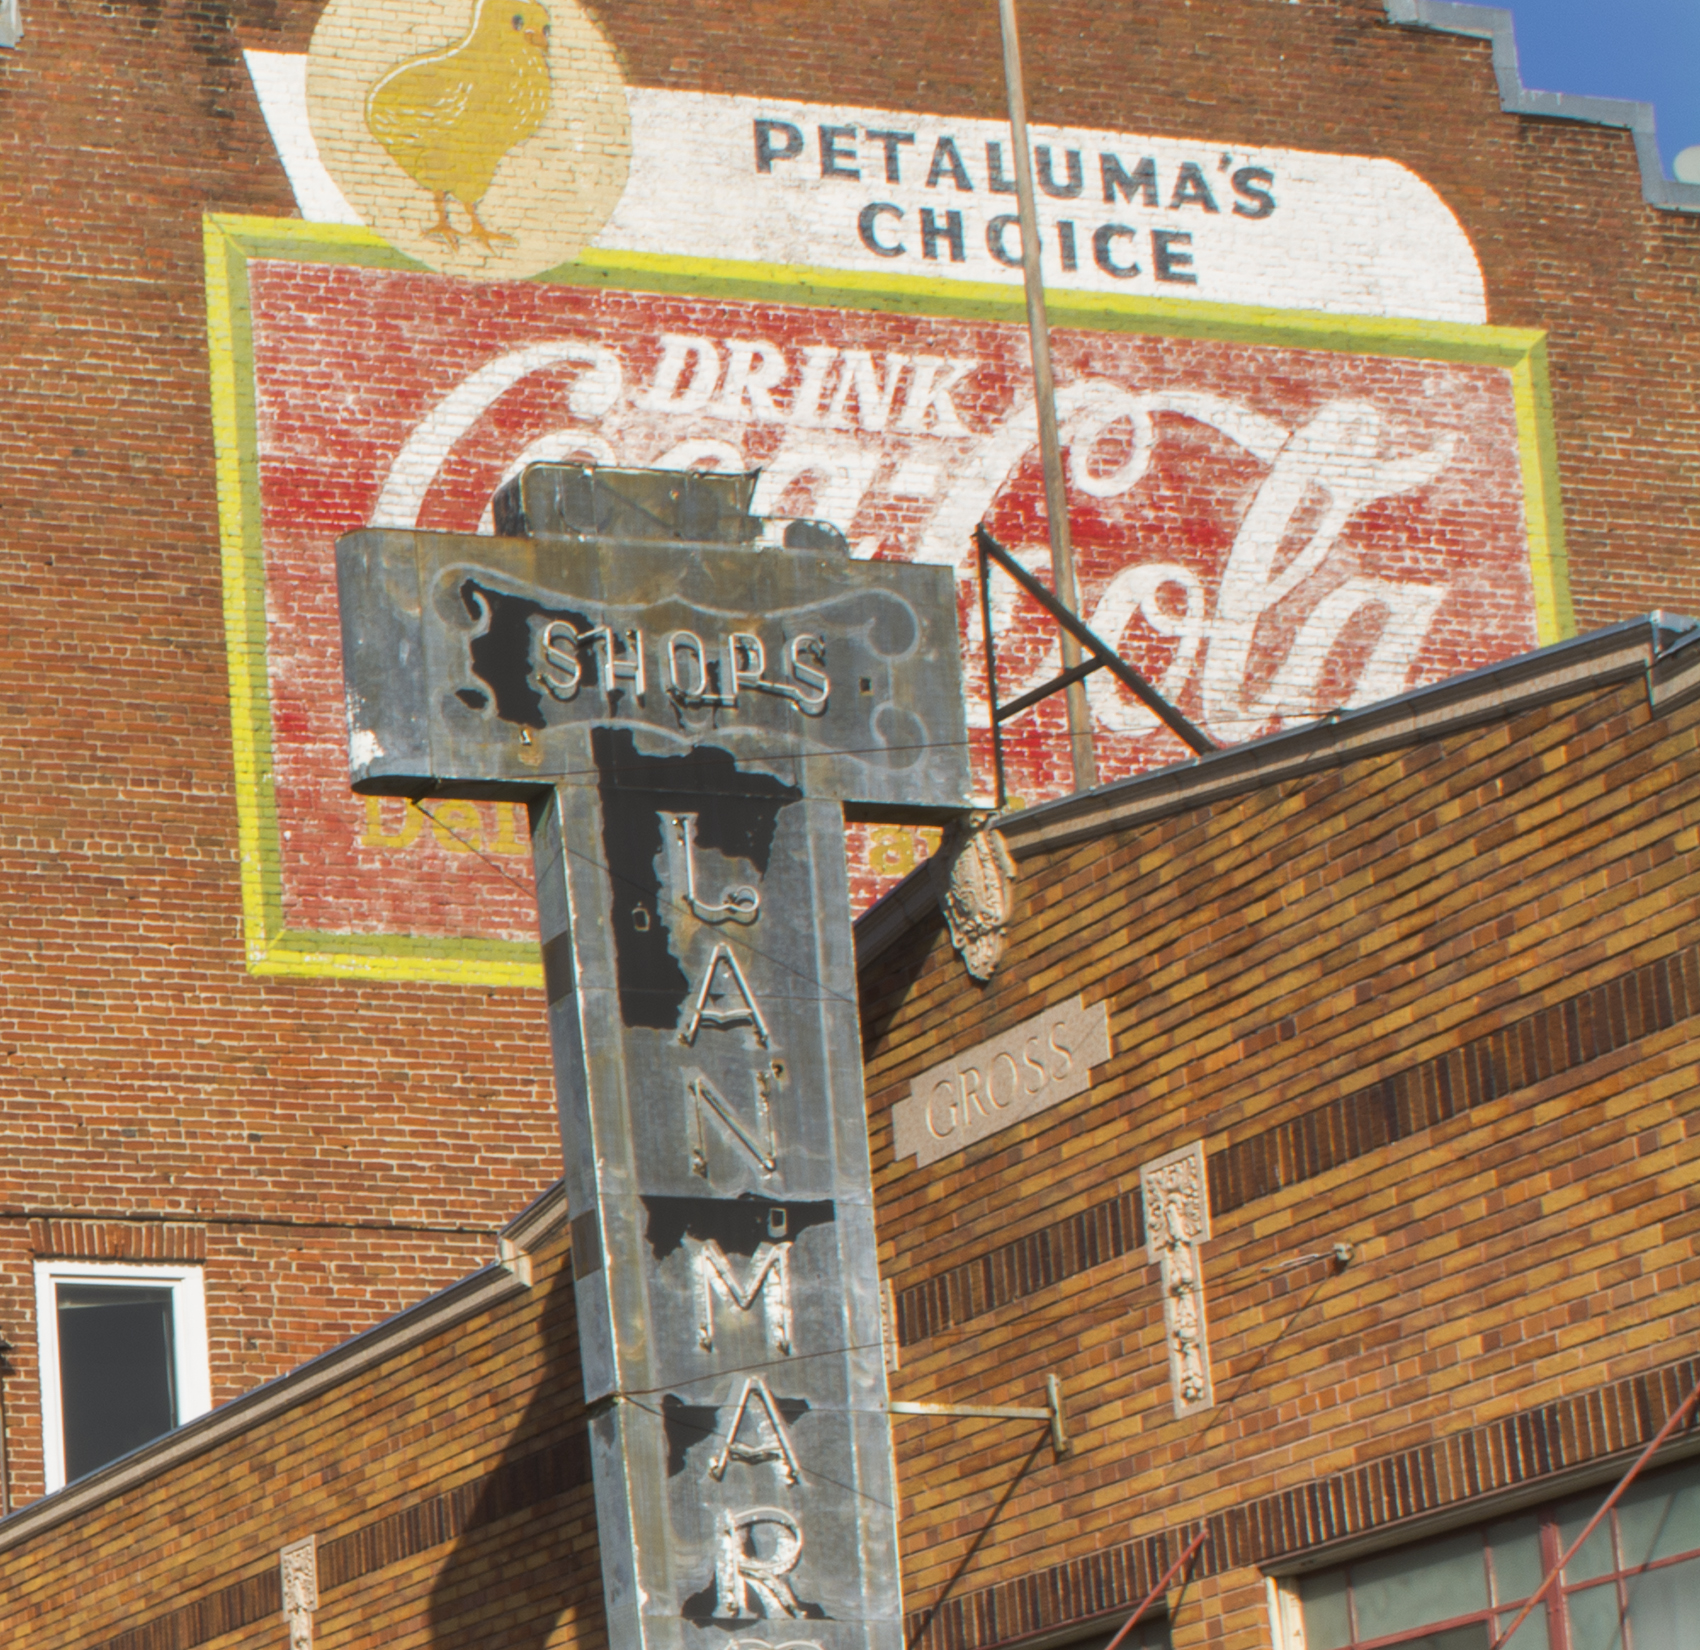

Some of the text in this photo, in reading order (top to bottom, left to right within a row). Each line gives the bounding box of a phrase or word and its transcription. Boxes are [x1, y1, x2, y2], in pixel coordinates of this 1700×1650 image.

[752, 118, 1279, 221] PETALUMA'S
[855, 201, 1199, 285] CHOICE
[636, 333, 980, 437] DRINK
[538, 619, 831, 712] SHOPS
[923, 1020, 1075, 1142] GROSS
